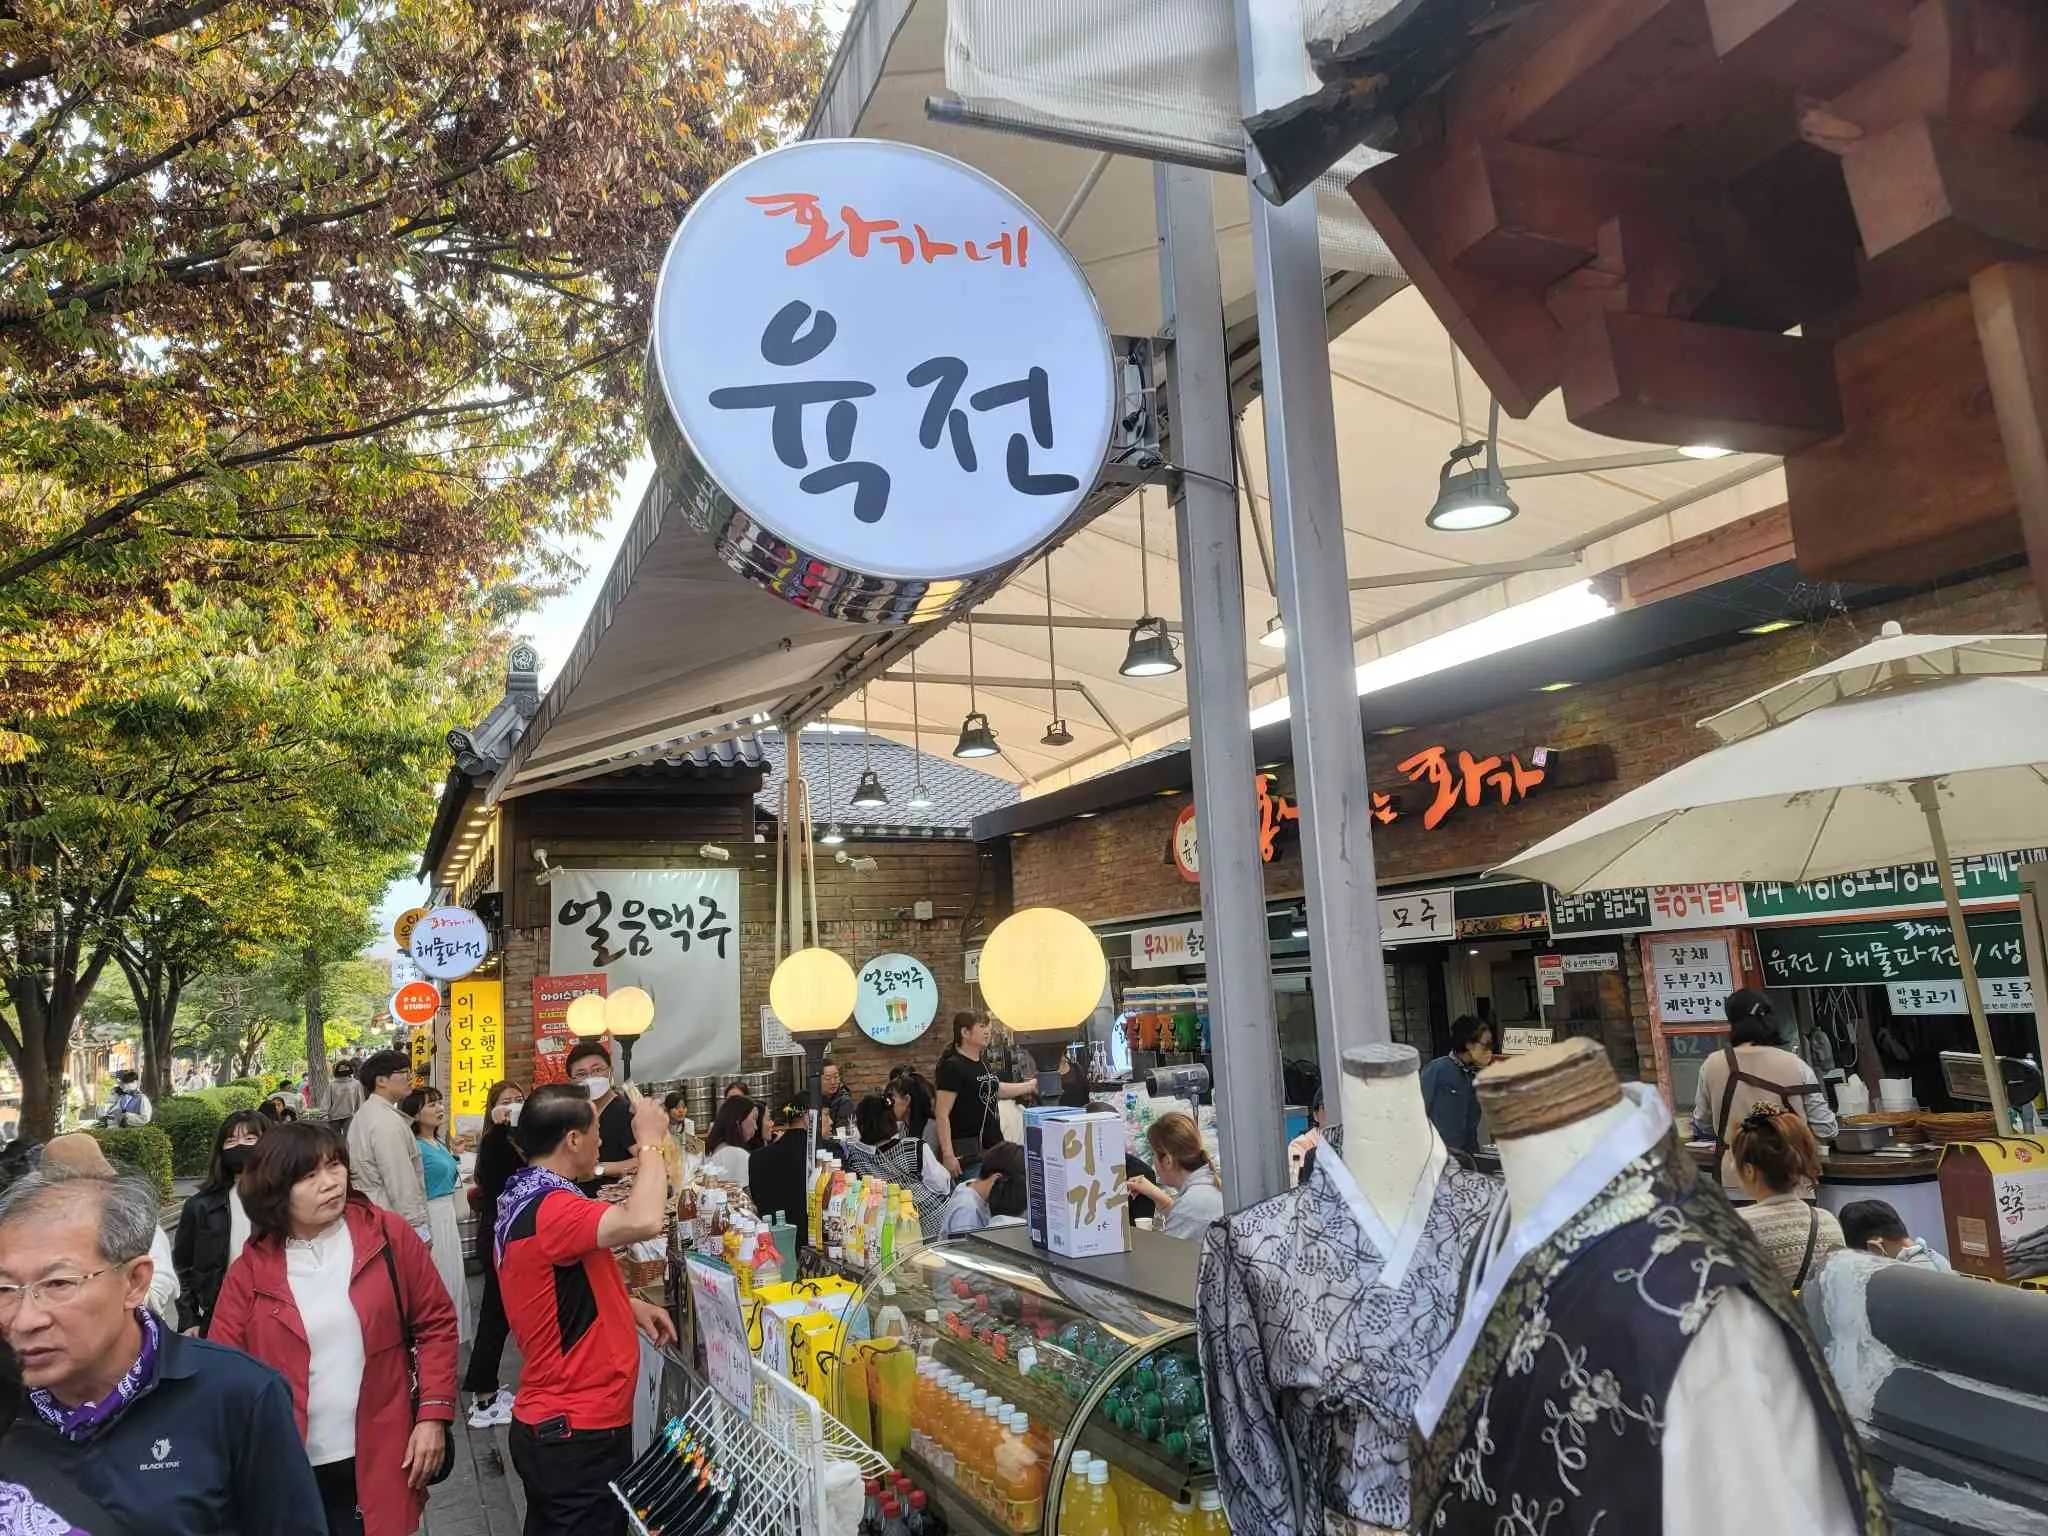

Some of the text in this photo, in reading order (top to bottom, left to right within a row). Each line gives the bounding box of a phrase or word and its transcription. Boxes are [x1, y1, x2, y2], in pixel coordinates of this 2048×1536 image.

[708, 299, 1081, 524] 육전
[558, 890, 733, 967] 얼음맥주
[1392, 898, 1439, 932] 모주
[415, 936, 483, 967] 해물파전
[1669, 946, 1709, 966] 잡채
[863, 966, 926, 997] 얼음맥주
[1663, 971, 1724, 990] 두부김치
[457, 993, 475, 1097] 이리오너라
